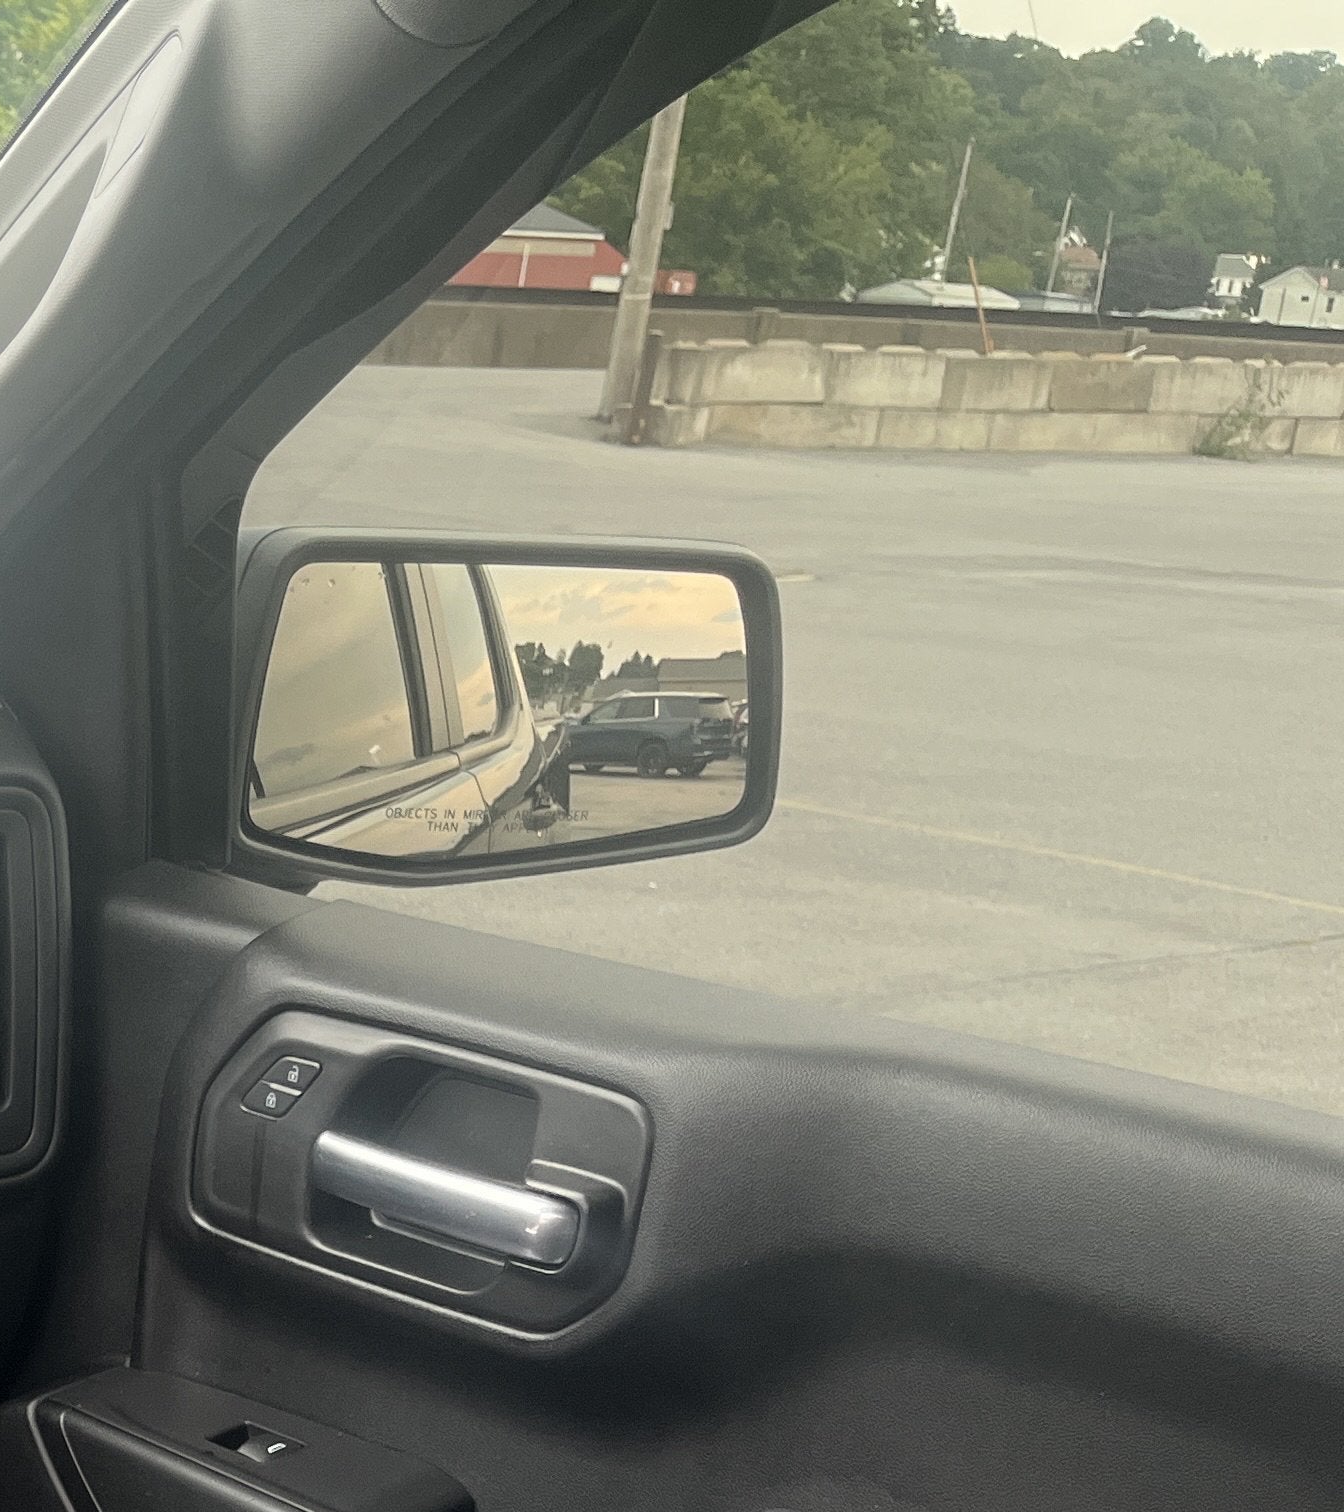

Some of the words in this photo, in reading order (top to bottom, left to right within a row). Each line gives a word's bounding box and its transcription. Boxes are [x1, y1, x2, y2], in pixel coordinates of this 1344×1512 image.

[385, 807, 438, 820] OBJECTS
[443, 809, 456, 820] IN
[463, 809, 507, 821] MIRR
[427, 821, 459, 833] THAN
